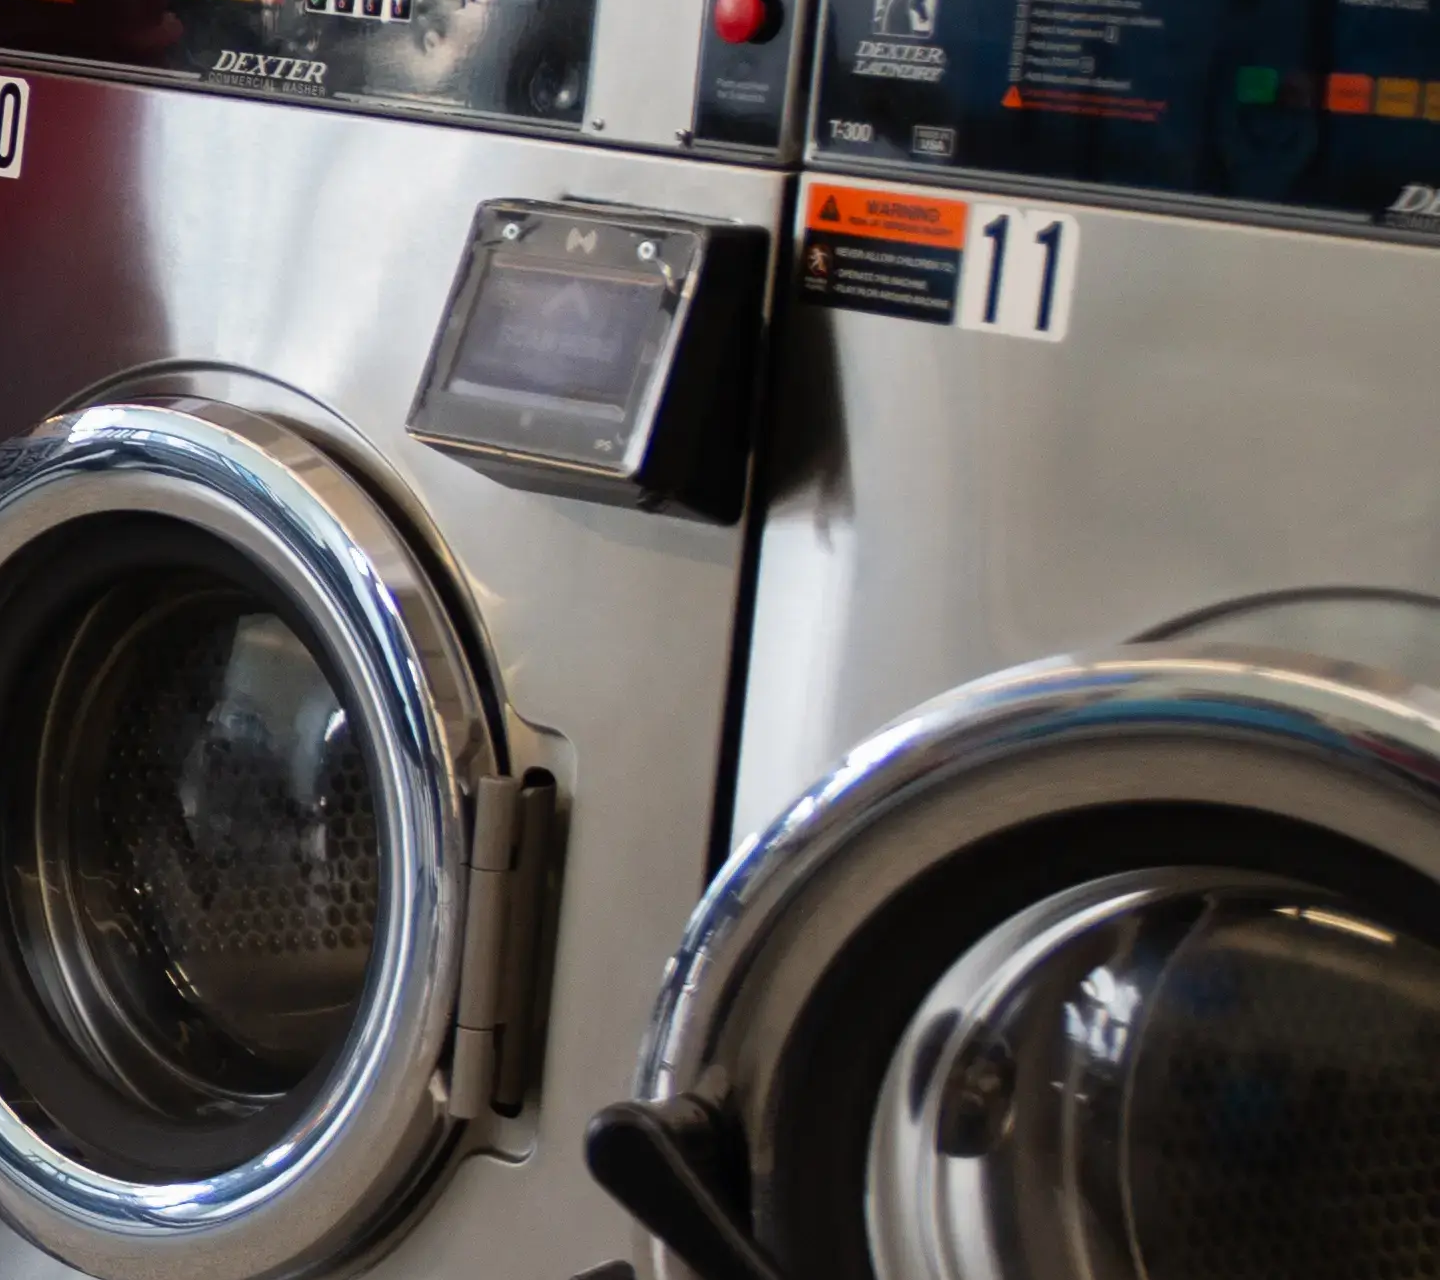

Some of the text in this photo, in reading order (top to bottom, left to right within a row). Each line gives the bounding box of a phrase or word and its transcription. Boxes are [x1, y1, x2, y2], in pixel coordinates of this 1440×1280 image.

[856, 40, 946, 64] DEXTER
[212, 49, 328, 84] DEXTER
[208, 71, 327, 97] COMMERCIAL WASHER
[830, 119, 873, 143] T-300
[982, 214, 1063, 331] 11
